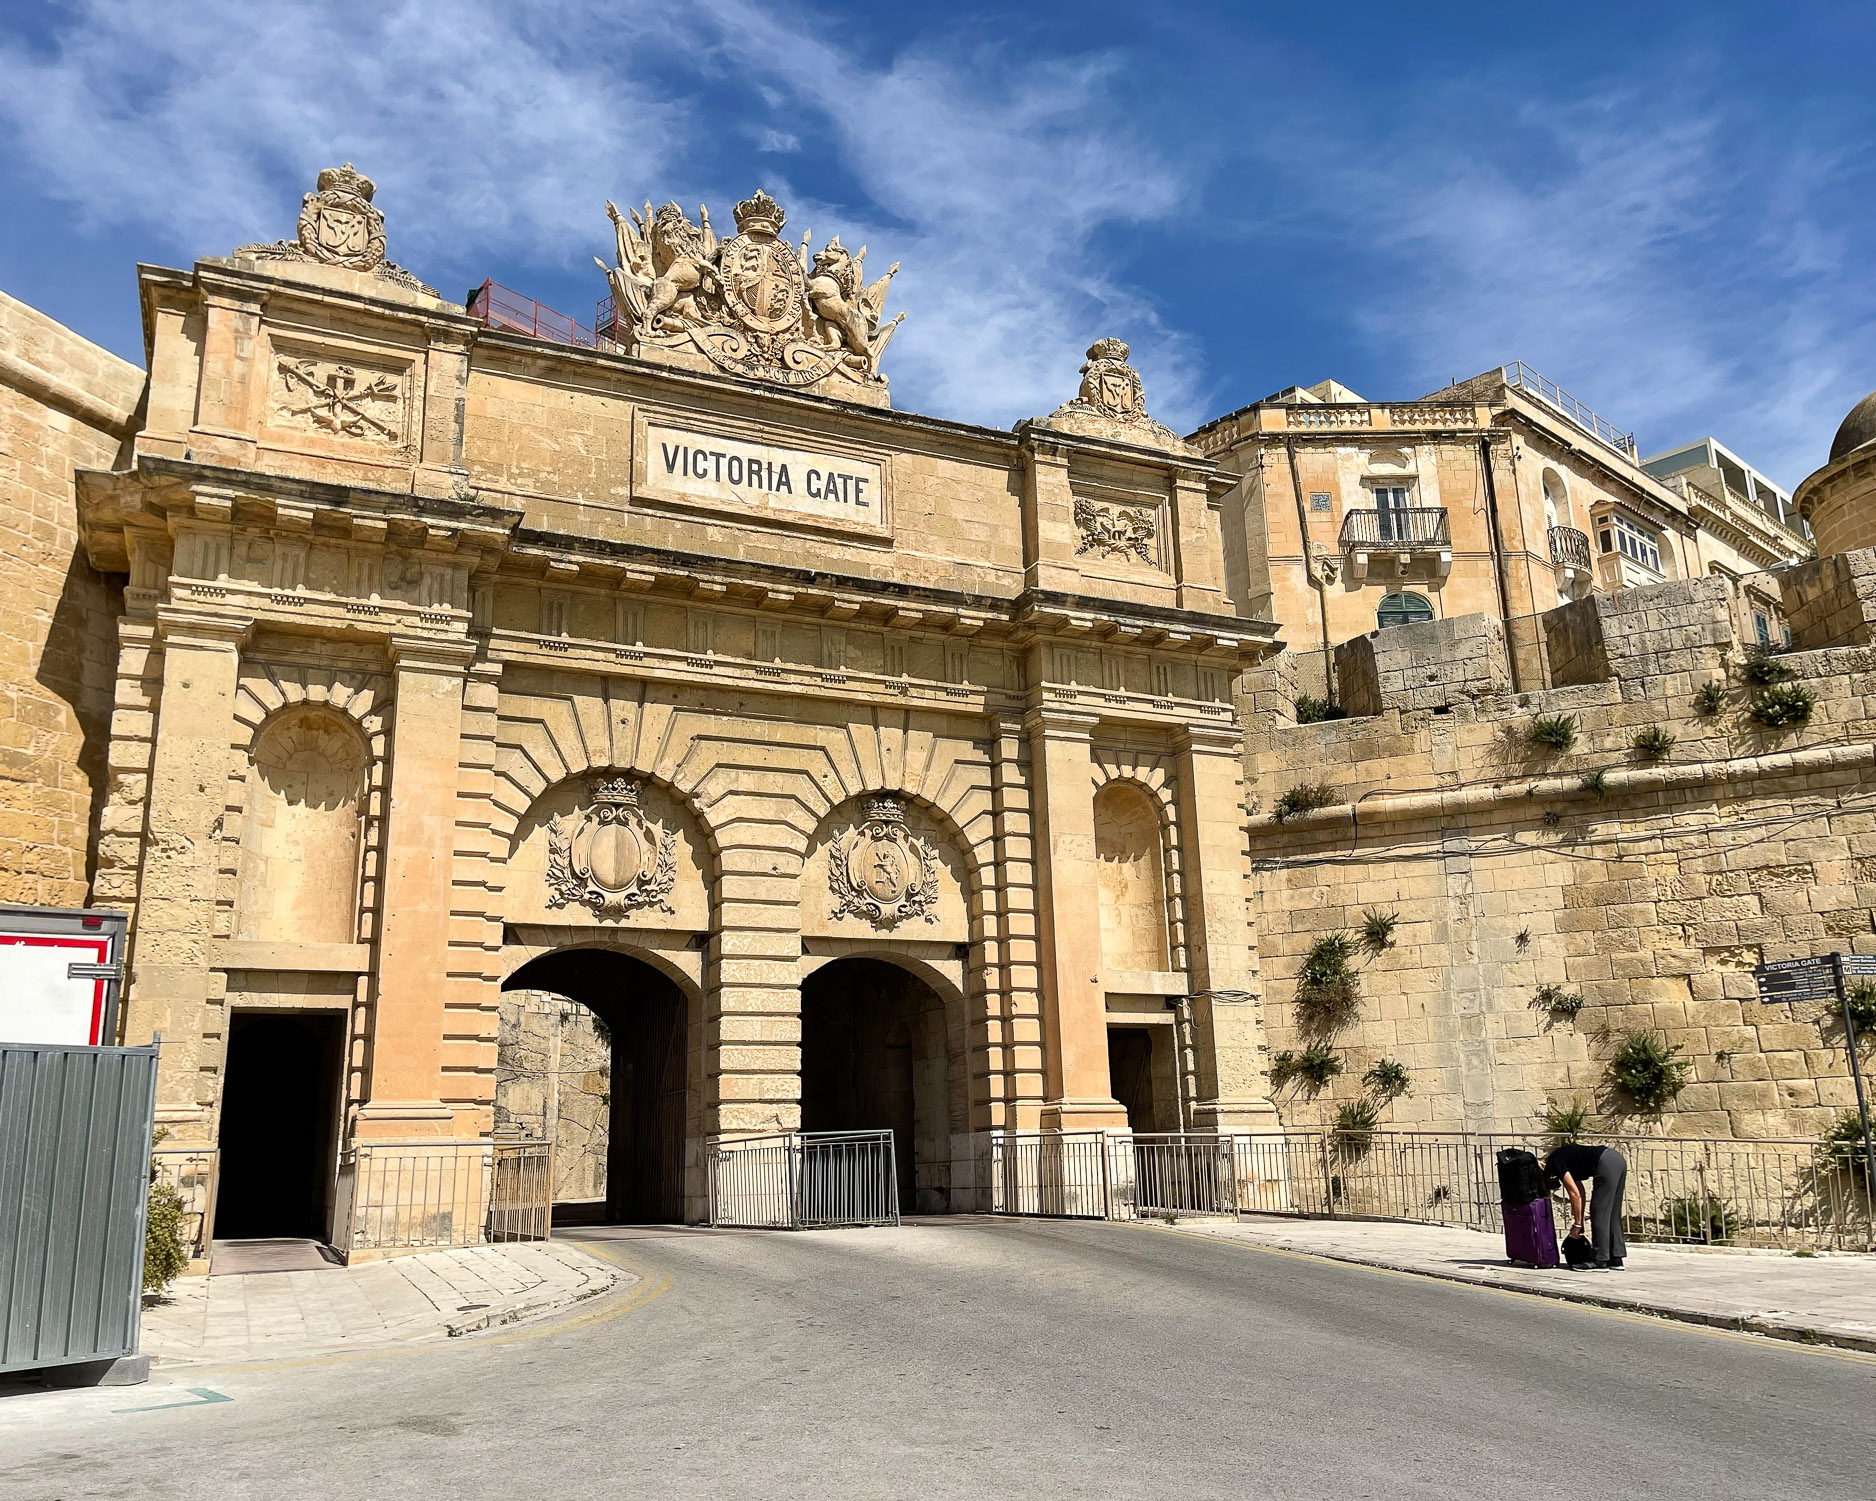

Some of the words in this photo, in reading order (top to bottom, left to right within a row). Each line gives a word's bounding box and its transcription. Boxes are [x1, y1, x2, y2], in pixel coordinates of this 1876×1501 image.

[661, 443, 793, 495] VICTORIA
[806, 469, 869, 508] GATE
[1764, 961, 1801, 971] VICTORIA
[1800, 958, 1822, 967] GATE
